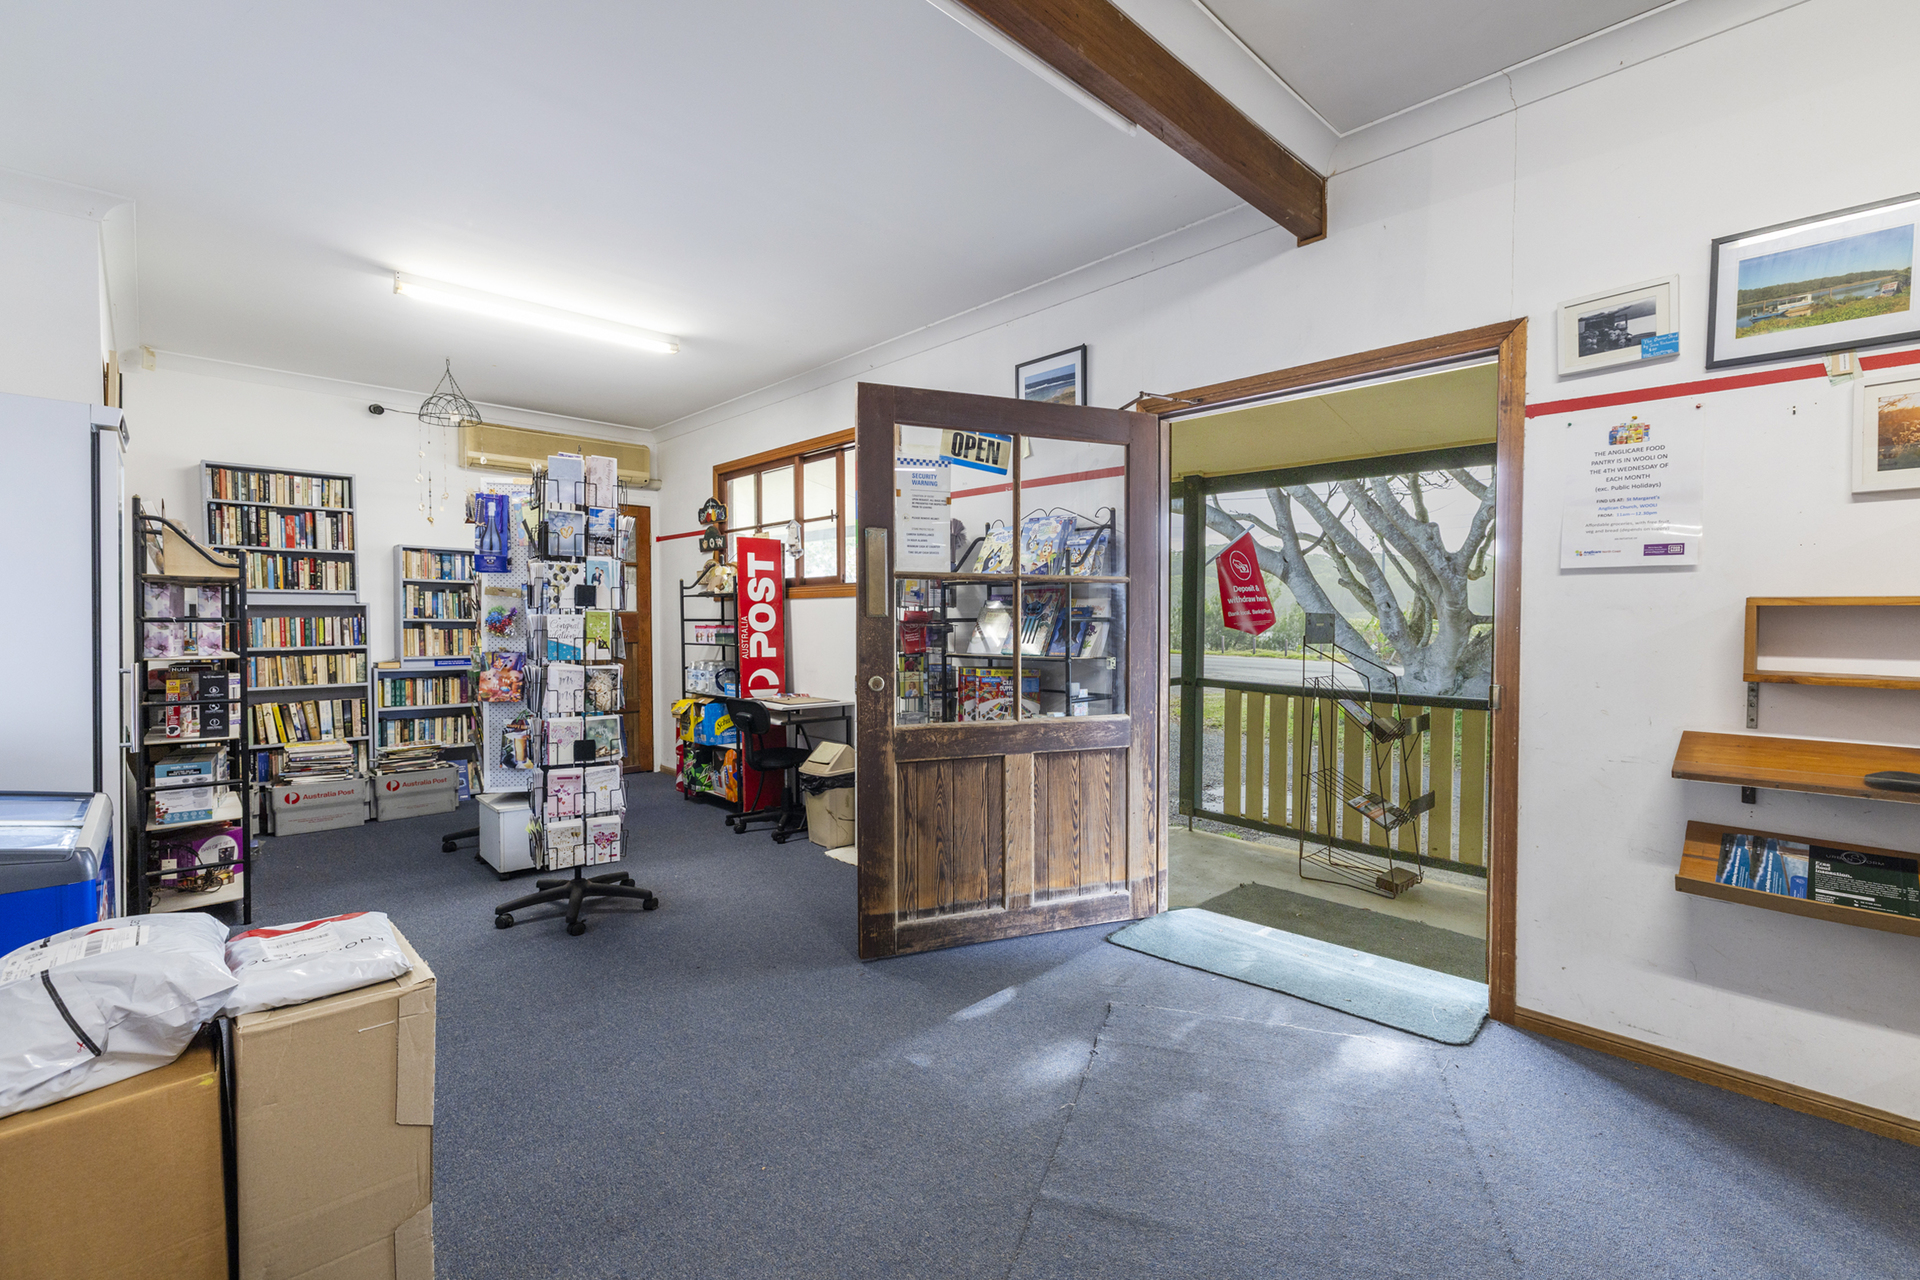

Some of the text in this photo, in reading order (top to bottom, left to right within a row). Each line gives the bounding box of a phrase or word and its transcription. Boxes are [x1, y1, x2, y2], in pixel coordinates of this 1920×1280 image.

[951, 431, 1001, 466] OPEN
[1607, 447, 1644, 456] ANGLICARE
[1645, 444, 1666, 452] FOOD
[1632, 454, 1656, 462] WOOLI
[1617, 463, 1658, 472] WEDNESDAY
[912, 472, 938, 480] SECURITY
[911, 479, 938, 487] WARNING
[1631, 481, 1662, 489] Holidays)
[1233, 585, 1255, 593] Deposit
[1227, 595, 1268, 604] withdraw here
[746, 552, 777, 658] POST
[741, 615, 750, 659] AUSTRALIA
[402, 777, 448, 788] Australia Post
[302, 788, 355, 801] Australia Post
